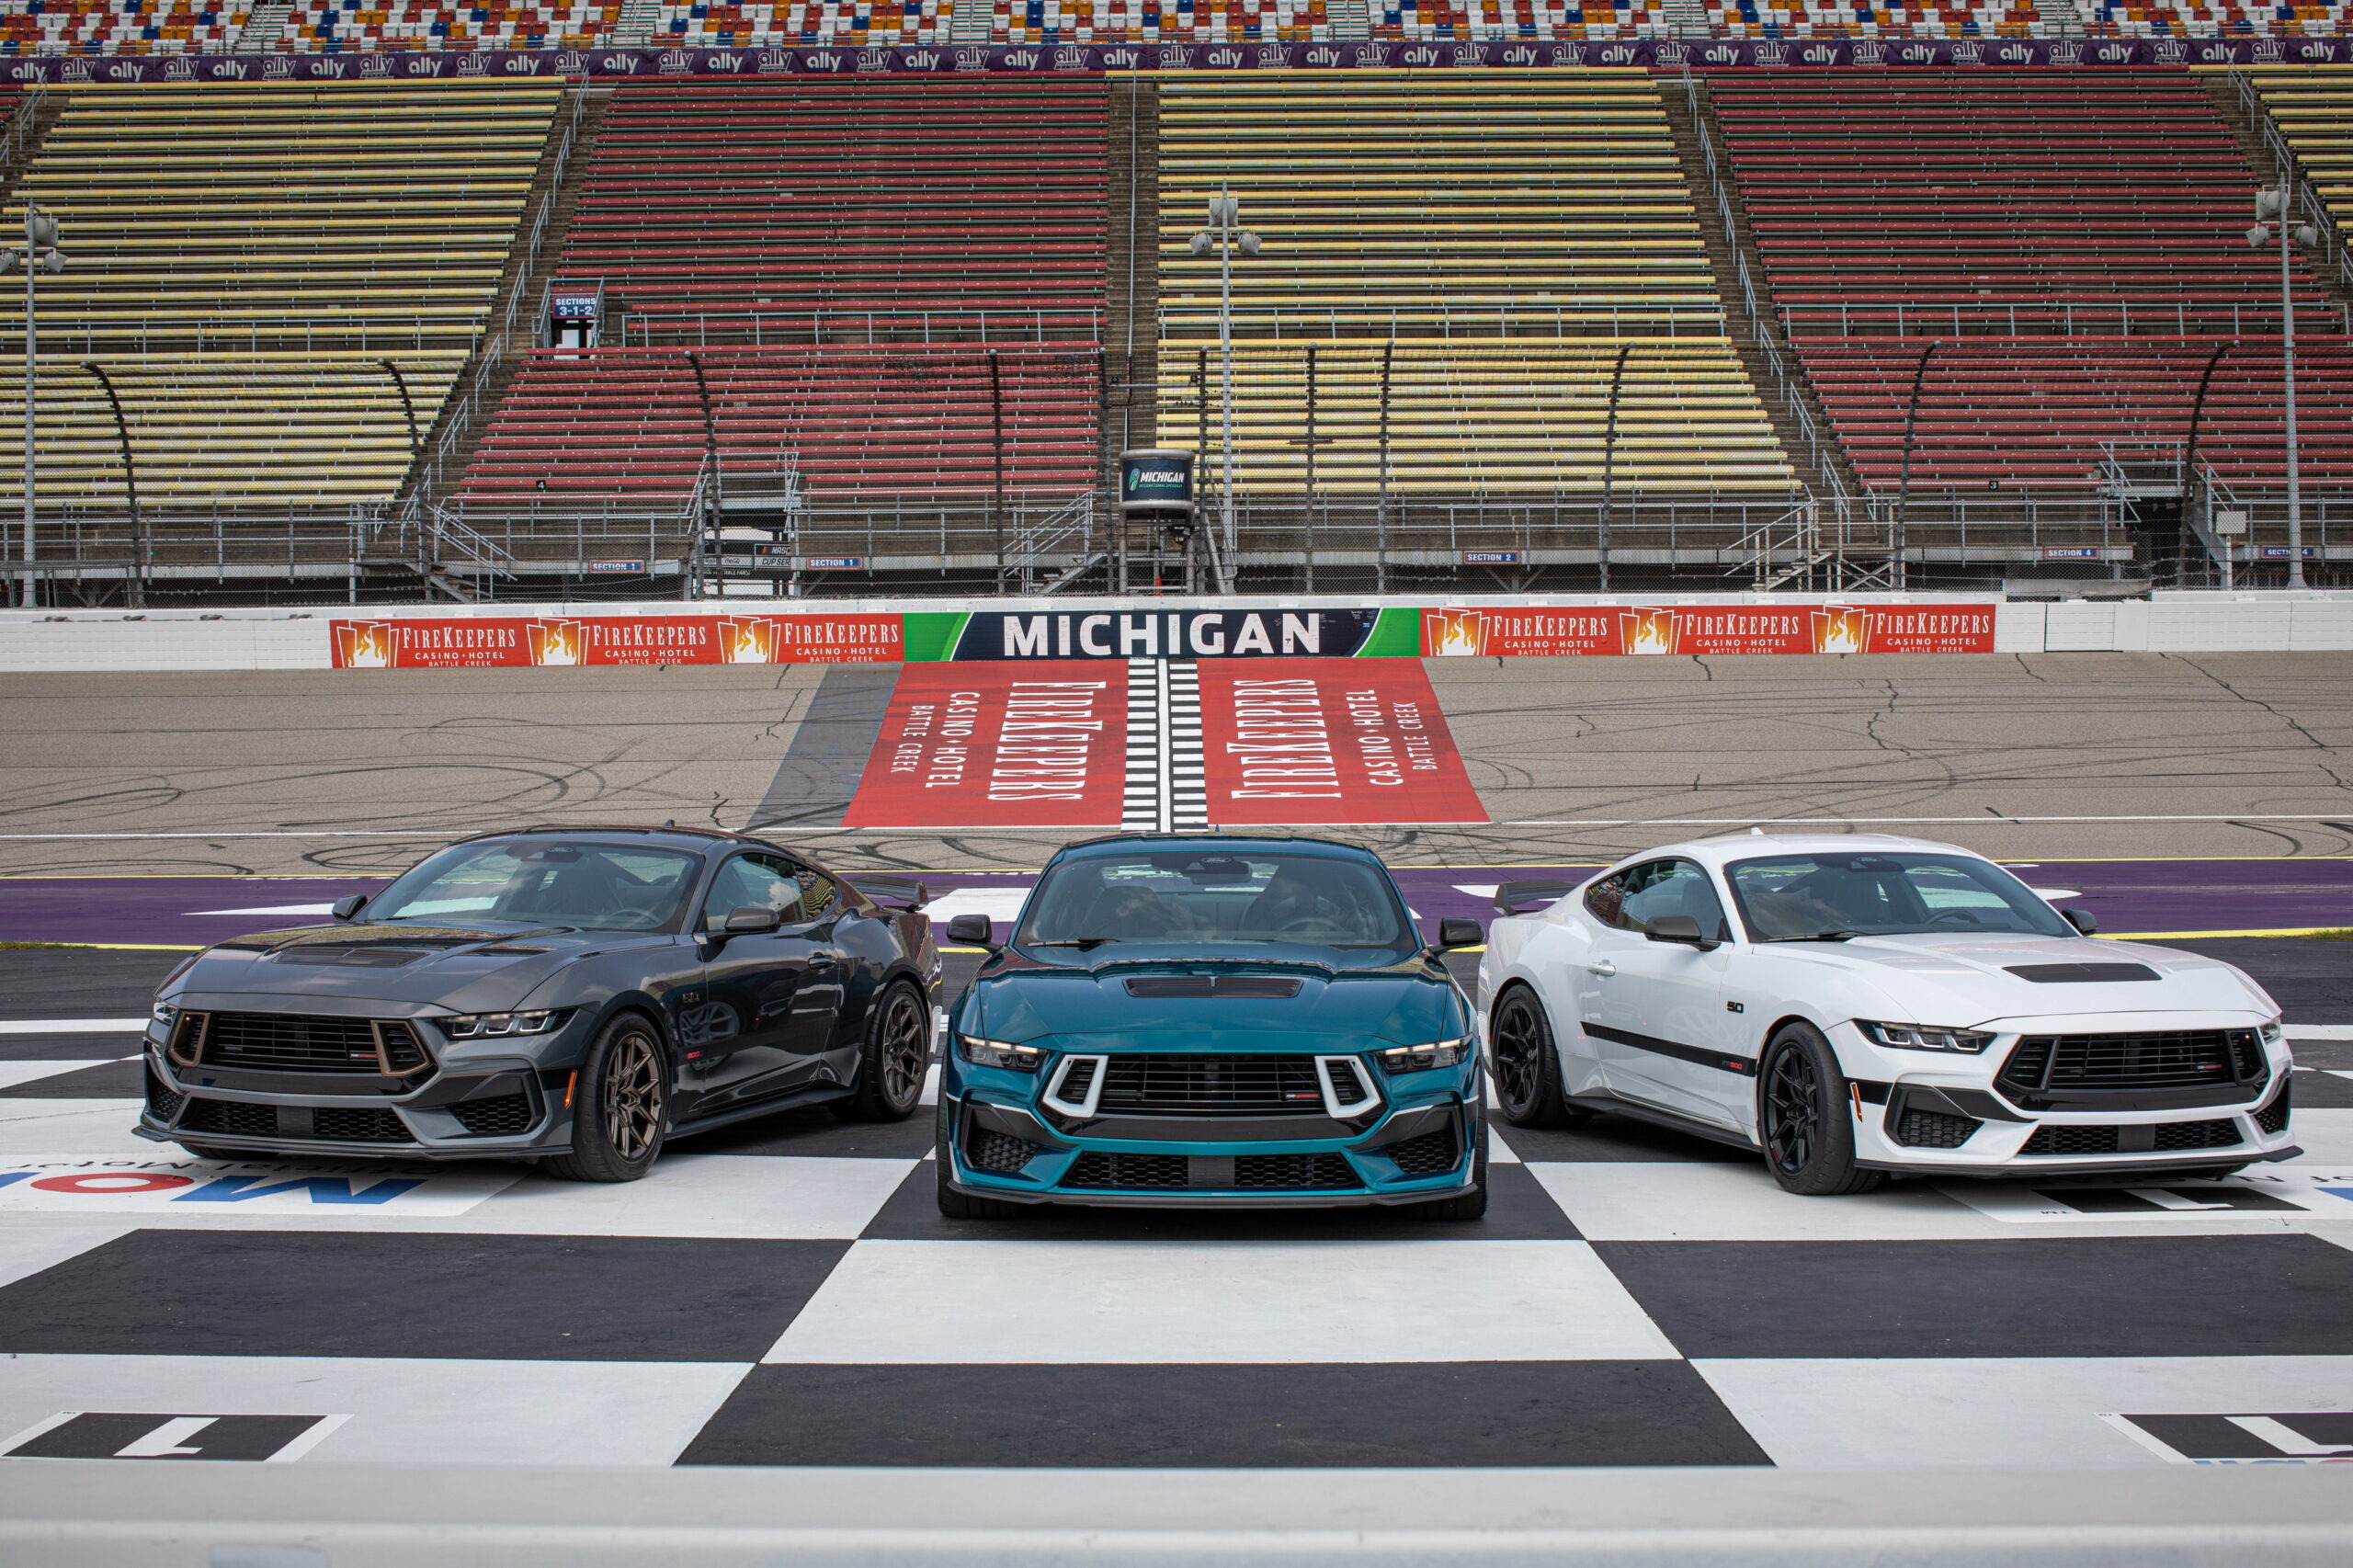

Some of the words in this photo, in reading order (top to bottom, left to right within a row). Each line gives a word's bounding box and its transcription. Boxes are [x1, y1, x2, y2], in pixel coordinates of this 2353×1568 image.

[904, 51, 940, 71] ally
[1004, 51, 1040, 70] ally
[1103, 49, 1139, 69] ally
[1208, 49, 1244, 68] ally
[1306, 47, 1341, 67] ally
[1404, 47, 1439, 67] ally
[1503, 46, 1538, 66] ally
[1600, 45, 1636, 64] ally
[1704, 45, 1740, 65] ally
[1802, 45, 1838, 65] ally
[1902, 45, 1937, 64] ally
[1999, 44, 2034, 64] ally
[2098, 44, 2133, 63] ally
[2201, 44, 2236, 63] ally
[2301, 42, 2336, 62] ally
[11, 62, 46, 80] ally
[109, 62, 144, 82] ally
[212, 61, 248, 80] ally
[311, 59, 346, 79] ally
[408, 57, 443, 77] ally
[505, 55, 540, 75] ally
[603, 54, 639, 74] ally
[708, 53, 744, 74] ally
[806, 52, 842, 73] ally
[555, 298, 597, 306] SECTIONS
[559, 306, 594, 316] 3-1-2
[1140, 472, 1185, 483] MICHIGAN
[810, 559, 845, 567] SECTION
[2048, 549, 2082, 557] SECTION
[593, 562, 627, 571] SECTION
[785, 622, 897, 644] FIREKEEPERS
[1494, 615, 1608, 637] FIREKEEPERS
[1685, 614, 1799, 635] FIREKEEPERS
[1876, 612, 1989, 634] FIREKEEPERS
[404, 628, 516, 649] FIREKEEPERS
[594, 625, 706, 646] FIREKEEPERS
[1003, 612, 1320, 656] MICHIGAN
[1505, 640, 1549, 648] CASINO
[1558, 640, 1596, 648] HOTEL
[1697, 639, 1741, 647] CASINO
[1750, 639, 1787, 647] HOTEL
[1887, 638, 1931, 646] CASINO
[1940, 638, 1977, 646] HOTEL
[415, 652, 459, 660] CASINO
[468, 652, 505, 660] HOTEL
[605, 649, 649, 657] CASINO
[658, 649, 696, 657] HOTEL
[796, 647, 840, 655] CASINO
[849, 647, 887, 655] HOTEL
[940, 691, 981, 736] CASINO
[1346, 689, 1384, 726] HOTEL
[1392, 702, 1424, 730] CREEK
[902, 705, 936, 737] BATTLE
[986, 681, 1107, 801] FIREKEEPERS
[1226, 679, 1342, 799] FIREKEEPERS
[890, 743, 923, 773] CREEK
[1358, 736, 1404, 786] CASINO
[1404, 735, 1438, 770] BATTLE
[925, 746, 968, 788] HOTEL
[0, 1172, 428, 1205] Mo
[113, 1417, 221, 1457] 1
